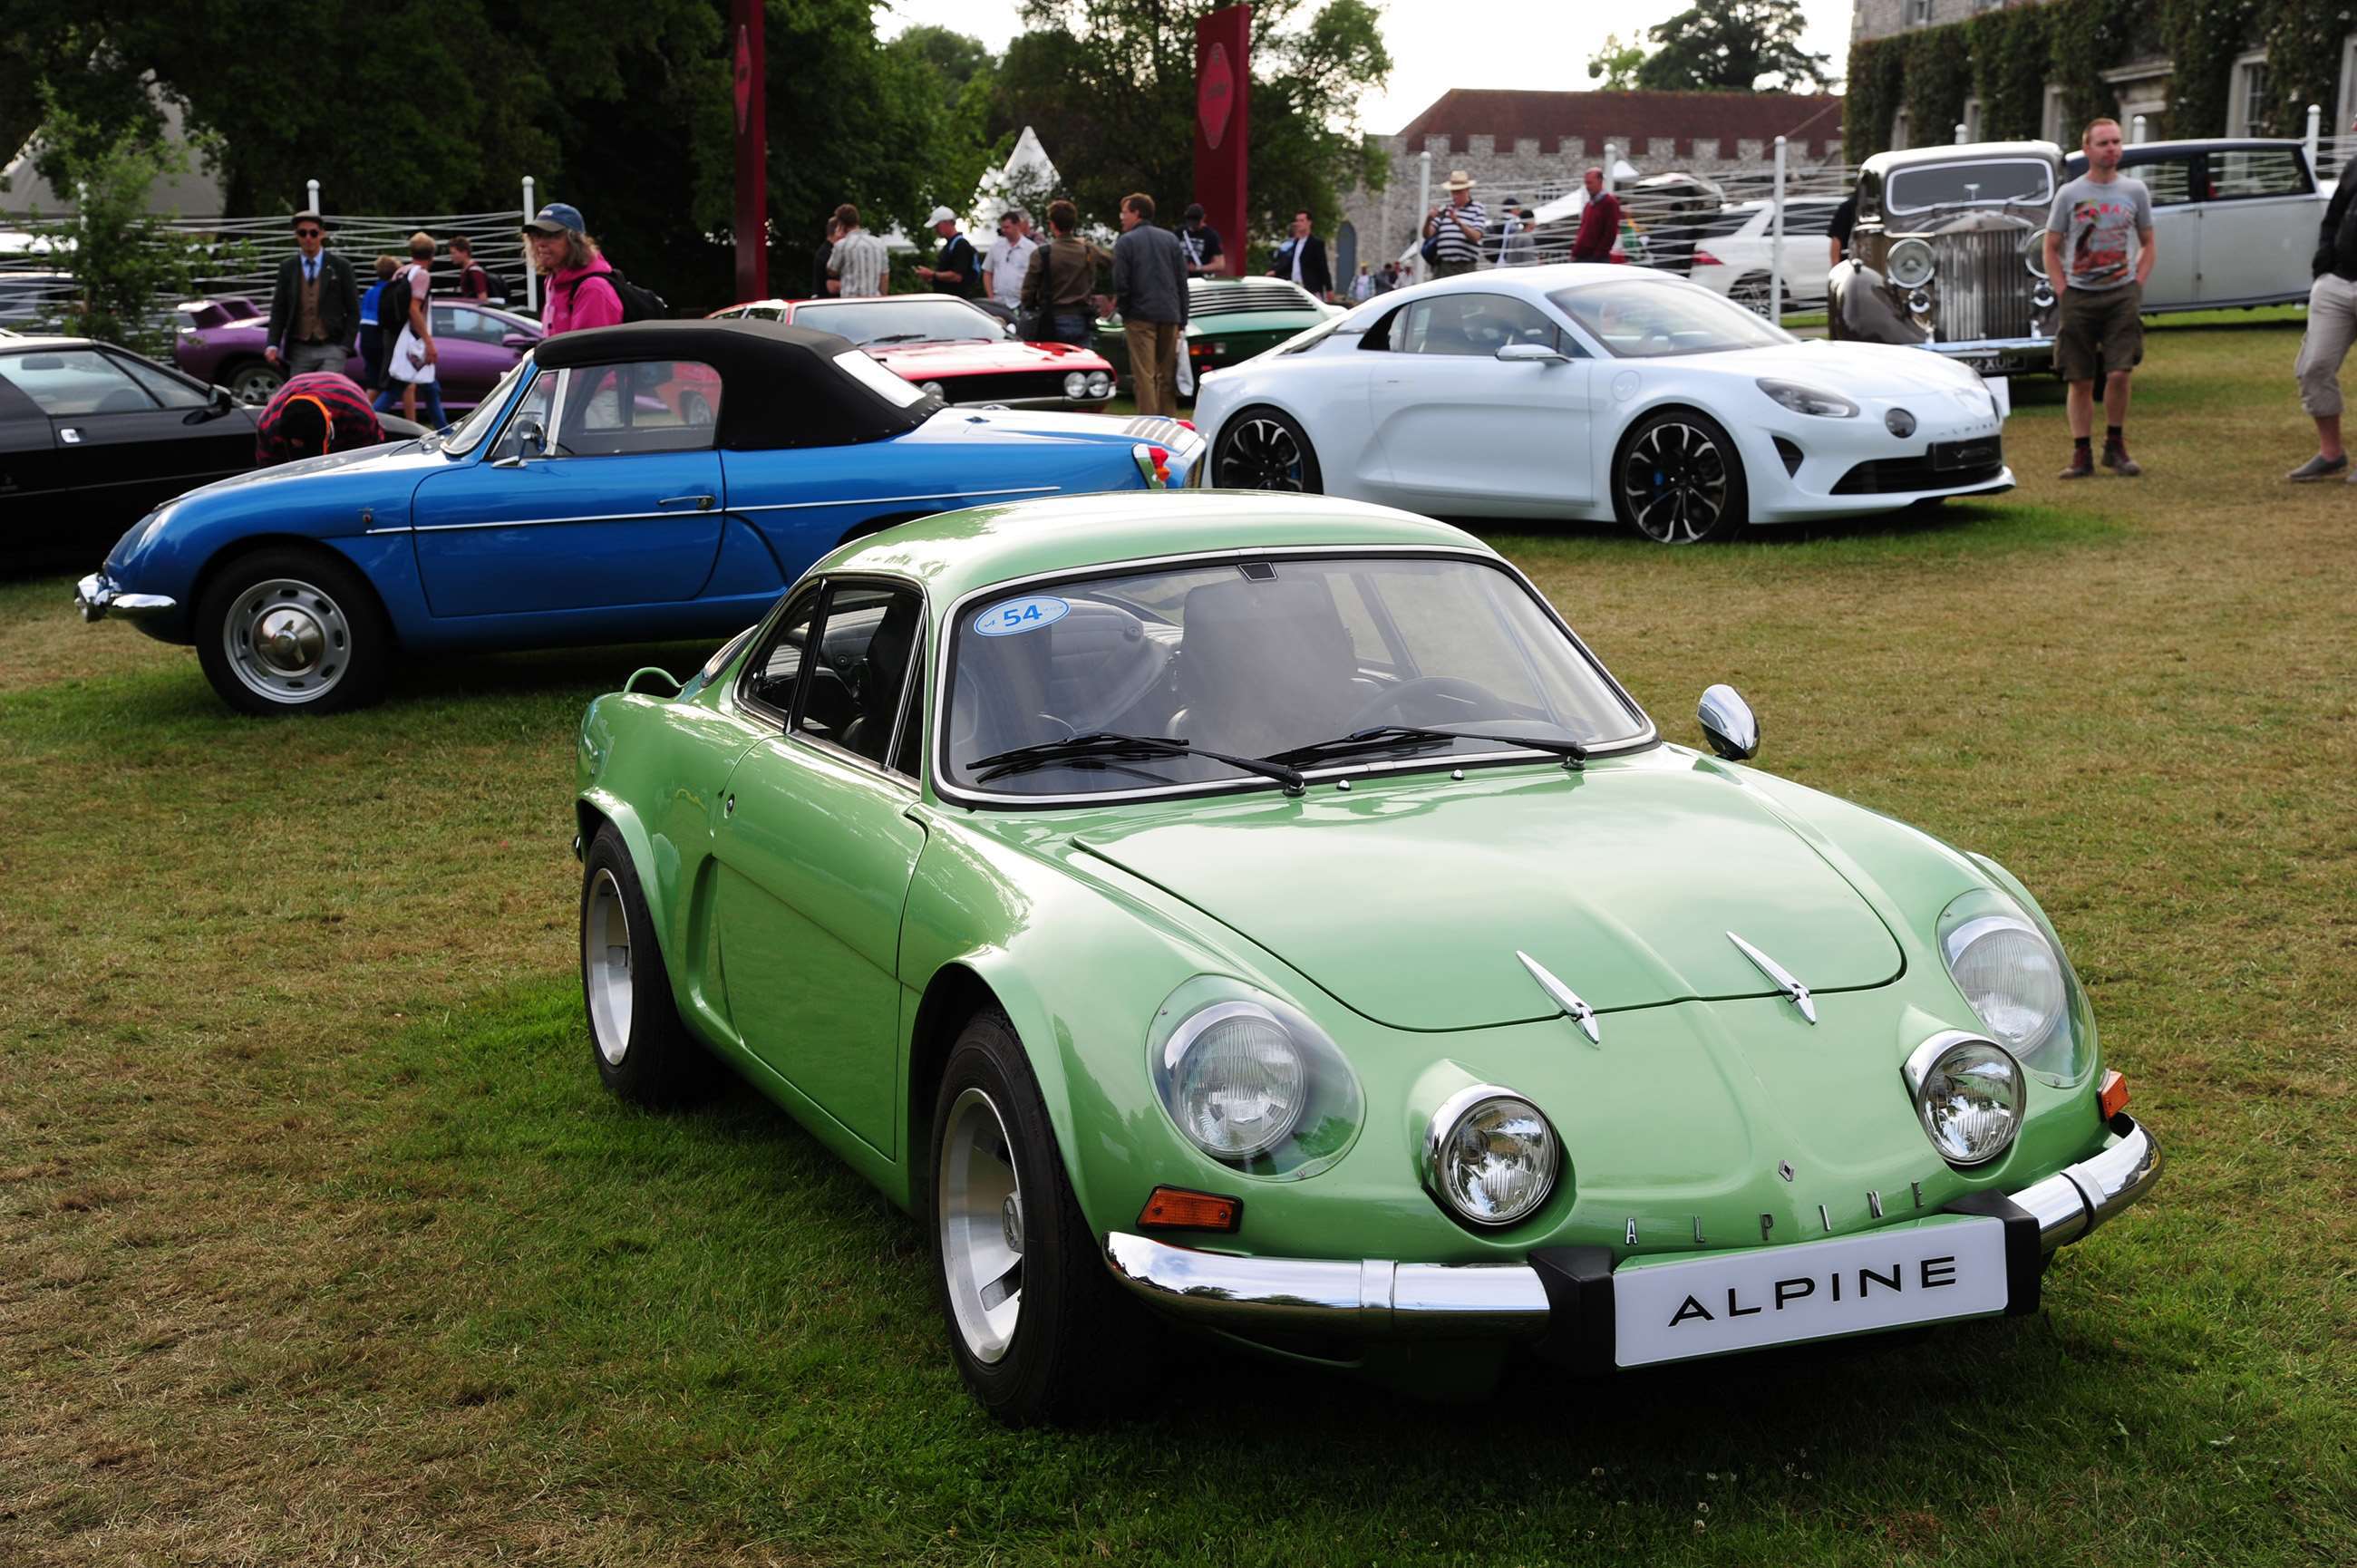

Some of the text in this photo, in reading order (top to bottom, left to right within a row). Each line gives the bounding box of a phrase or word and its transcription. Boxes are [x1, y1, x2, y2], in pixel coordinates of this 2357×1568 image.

[1003, 604, 1043, 627] 54
[1625, 1180, 1925, 1246] ALPINE
[1667, 1255, 1957, 1328] ALPINE
